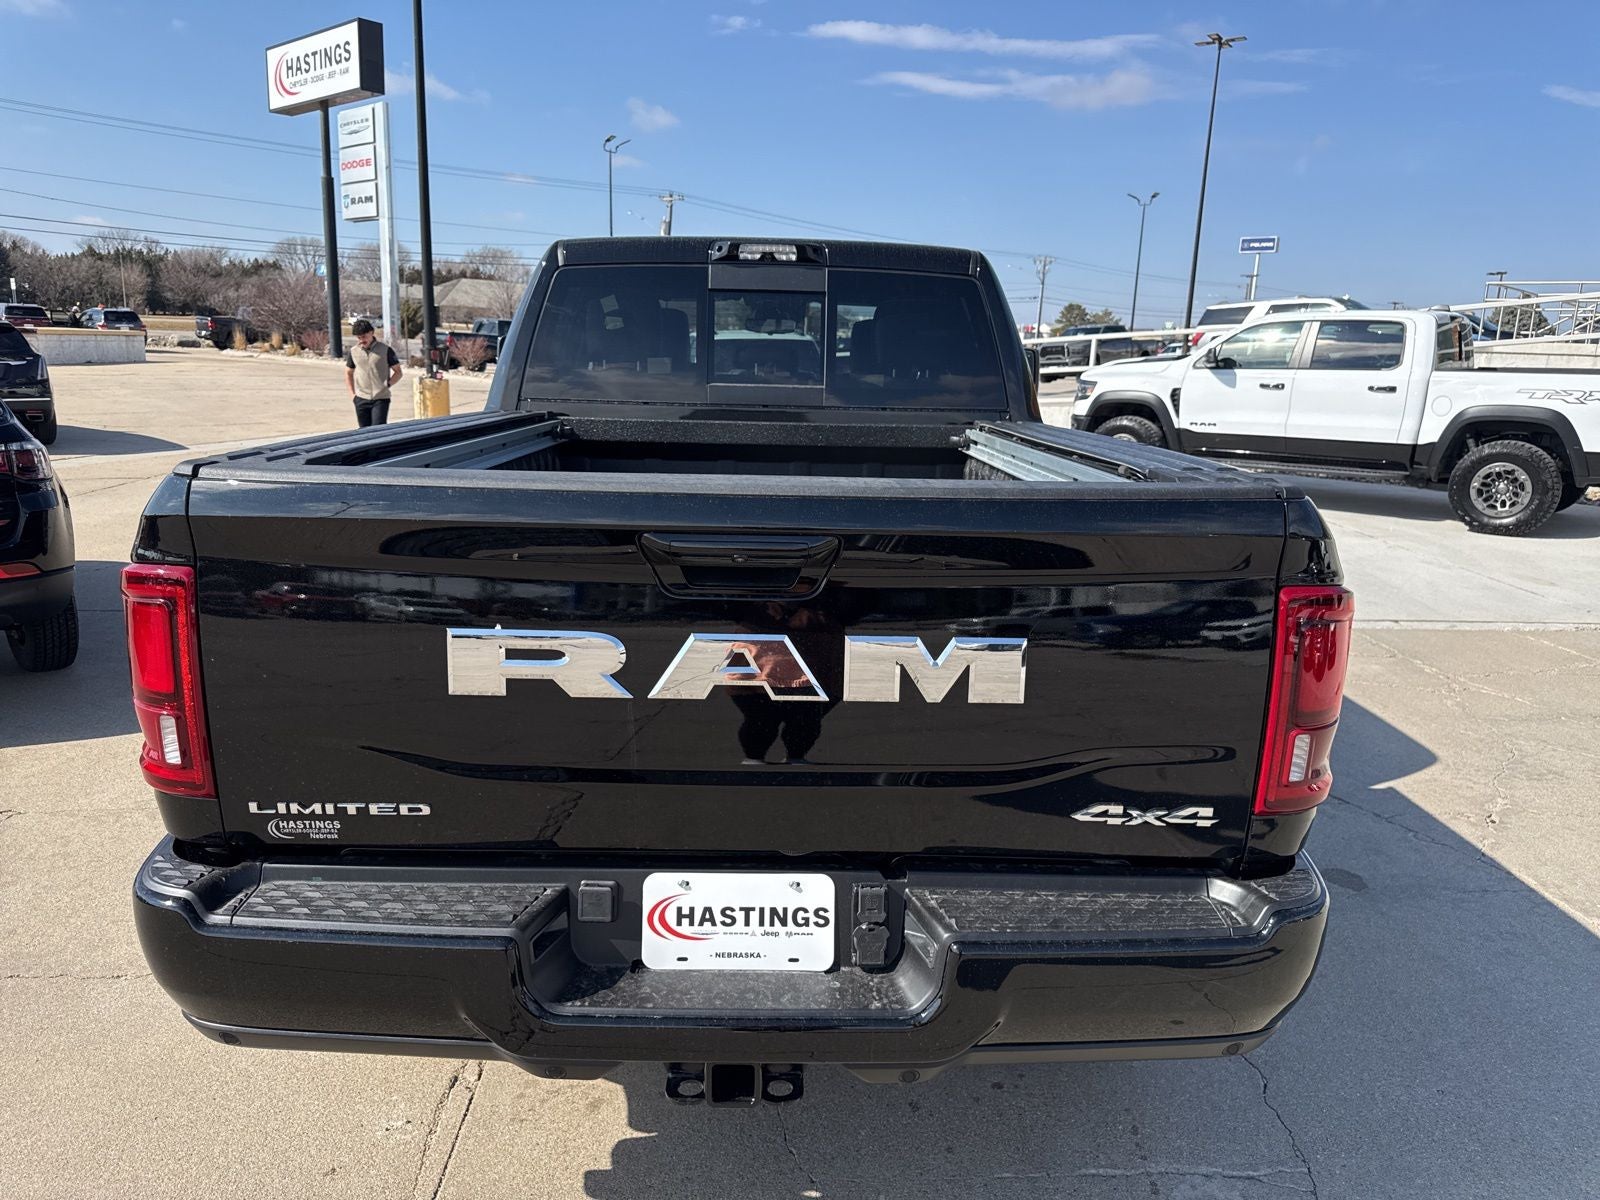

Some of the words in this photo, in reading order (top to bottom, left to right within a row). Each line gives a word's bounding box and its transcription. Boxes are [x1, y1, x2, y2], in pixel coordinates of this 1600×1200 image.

[286, 40, 351, 79] HASTINGS
[340, 118, 370, 128] CHRYSLER
[341, 158, 372, 171] DODGE
[350, 195, 374, 206] RAM
[446, 627, 1028, 704] RAM
[248, 801, 431, 816] LIMITED
[279, 820, 341, 829] HASTINGS
[676, 906, 831, 929] HASTINGS
[760, 929, 780, 938] Jeep
